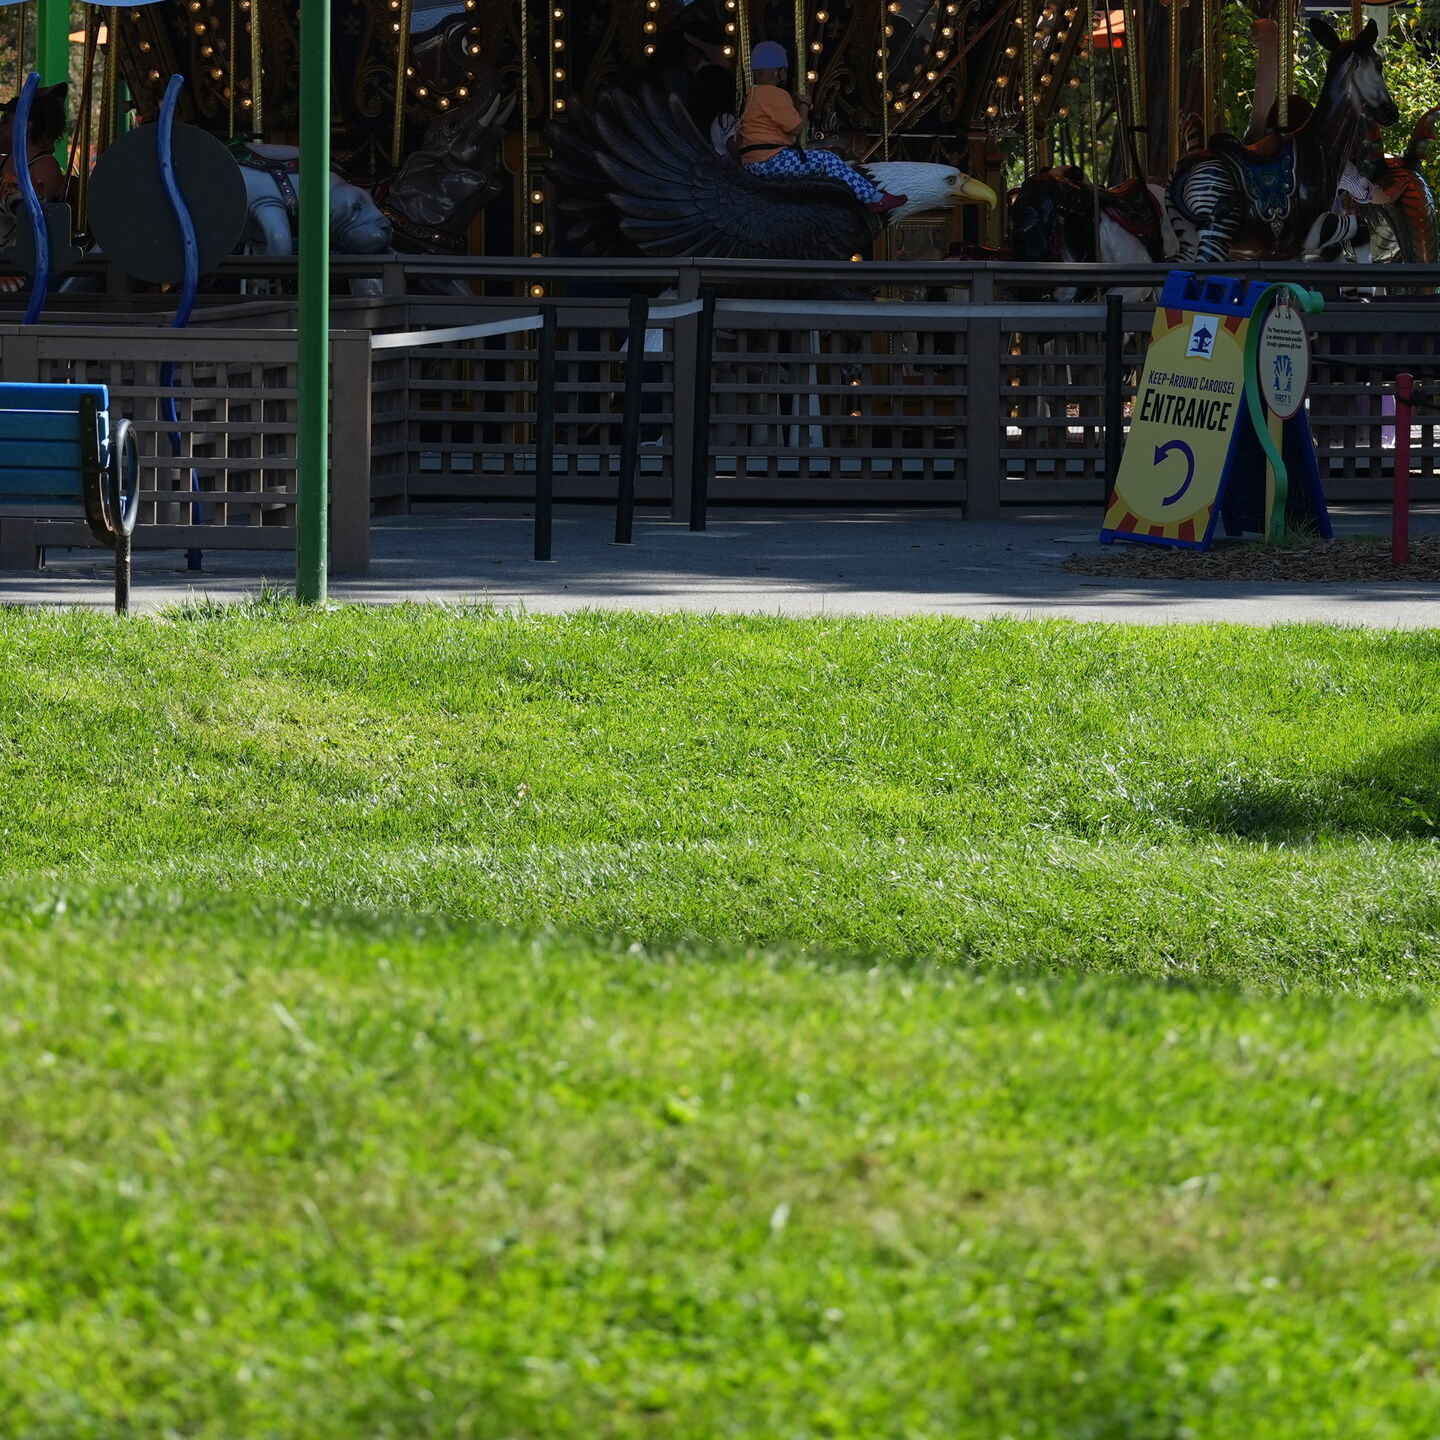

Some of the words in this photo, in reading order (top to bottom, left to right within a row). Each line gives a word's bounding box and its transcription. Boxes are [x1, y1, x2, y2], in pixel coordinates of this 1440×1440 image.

[1148, 370, 1198, 390] KEEP-AROUND
[1199, 376, 1236, 395] CAROUSEL
[1139, 388, 1232, 432] ENTRANCE
